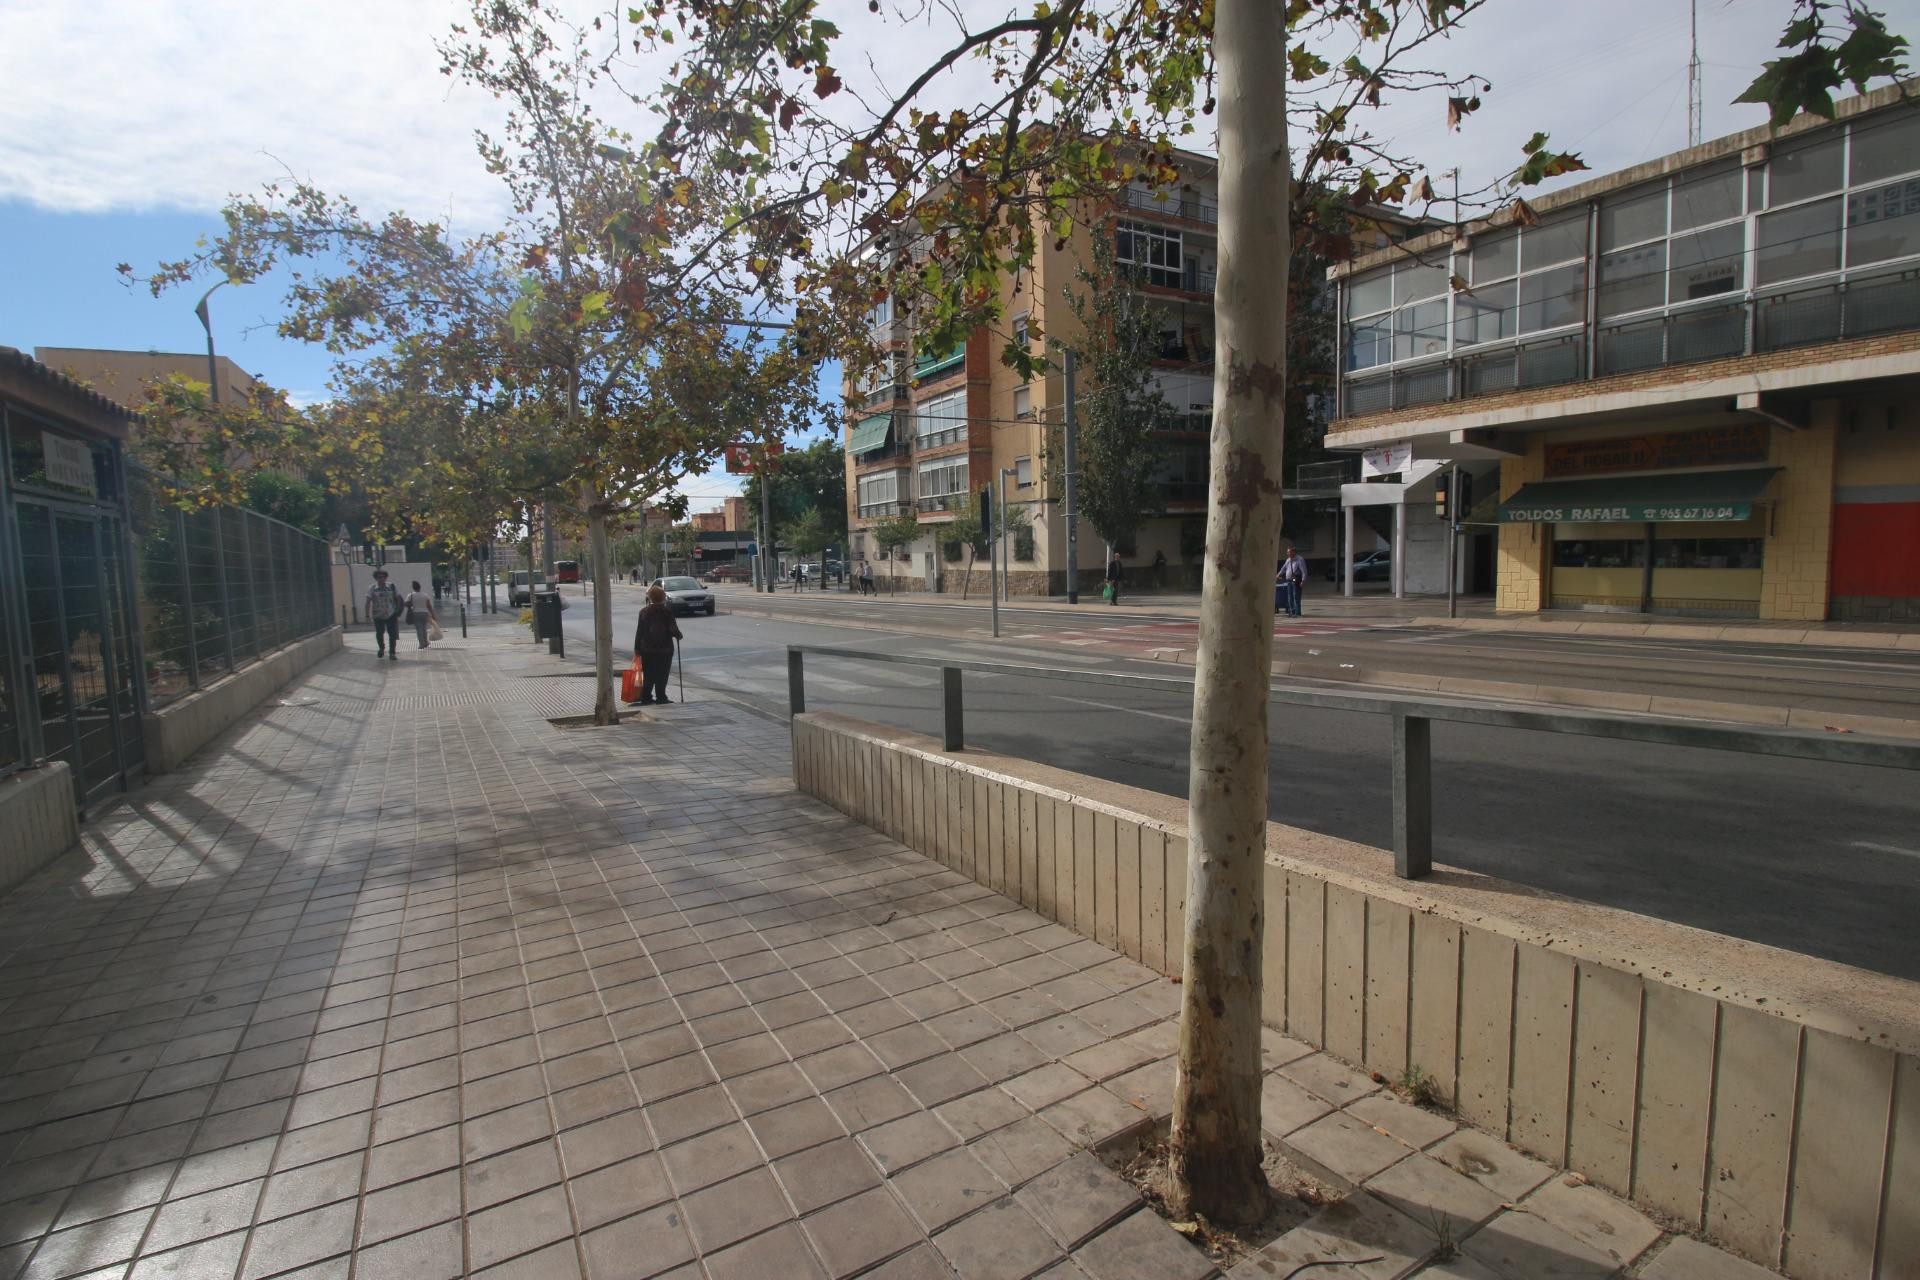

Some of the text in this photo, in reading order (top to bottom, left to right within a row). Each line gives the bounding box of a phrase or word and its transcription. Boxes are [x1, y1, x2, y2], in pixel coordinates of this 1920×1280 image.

[1583, 452, 1632, 467] HOGAR
[1508, 507, 1733, 521] TOLDOS RAFAEL 965 67 16 04
